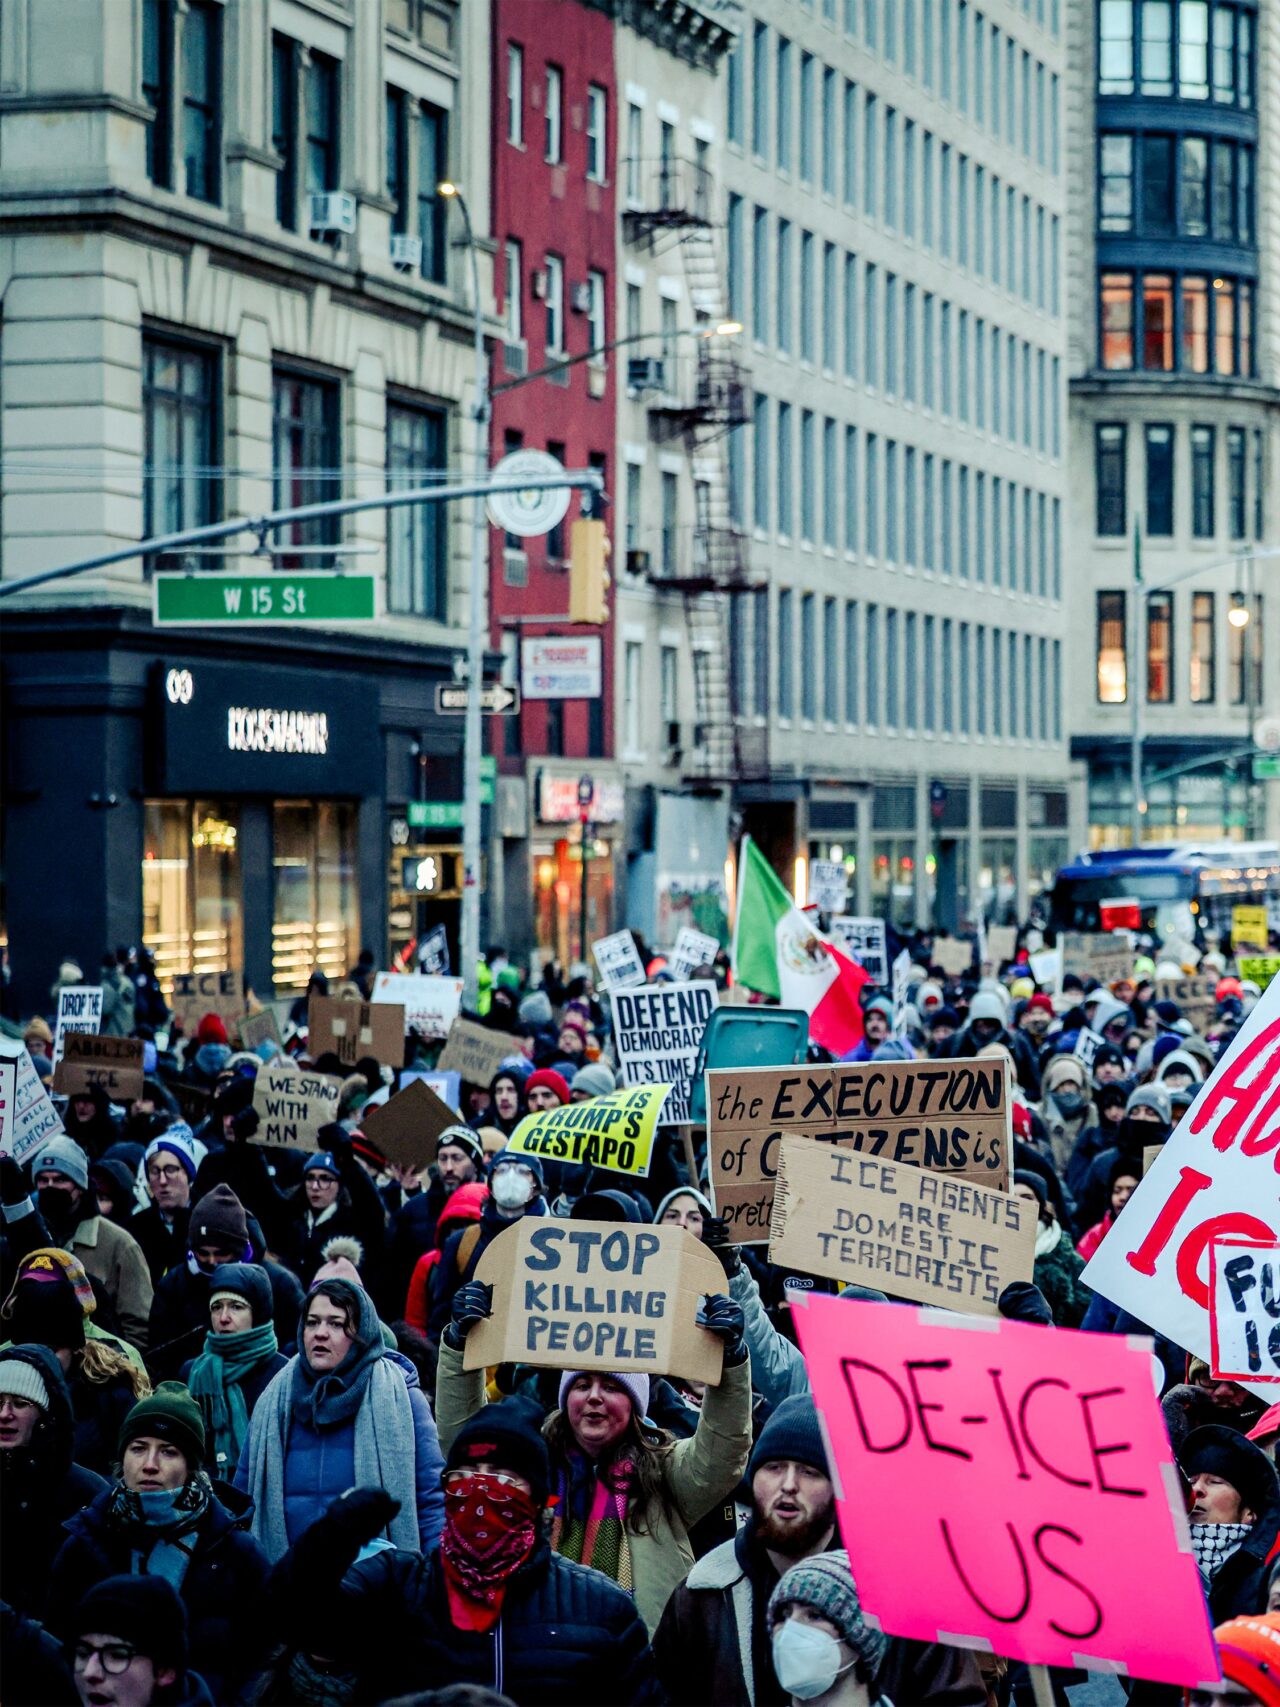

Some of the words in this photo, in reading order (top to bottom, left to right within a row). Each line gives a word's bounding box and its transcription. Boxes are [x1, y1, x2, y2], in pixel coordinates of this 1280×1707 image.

[223, 587, 242, 613] W
[251, 587, 273, 613] 15
[282, 586, 306, 613] St
[61, 993, 87, 1018] DROP
[175, 973, 234, 997] ICE
[616, 988, 713, 1031] DEFEND
[86, 1070, 119, 1088] ICE
[269, 1076, 295, 1094] WE
[298, 1079, 339, 1100] STAND
[626, 1058, 655, 1083] IT'S
[656, 1056, 690, 1082] TIME
[265, 1099, 308, 1120] WITH
[717, 1085, 763, 1121] the
[770, 1068, 1001, 1120] EXECUTION
[266, 1124, 297, 1142] MN
[536, 1107, 644, 1140] TRUMP'S
[522, 1126, 637, 1170] GESTAPO
[720, 1137, 752, 1177] of
[973, 1131, 1001, 1170] is
[721, 1196, 773, 1229] prett
[830, 1153, 898, 1195] ICE
[919, 1175, 1021, 1232] AGENTS
[898, 1202, 953, 1234] ARE
[1125, 1165, 1278, 1311] IC
[524, 1225, 661, 1276] STOP
[832, 1207, 1000, 1273] DOMESTIC
[816, 1231, 1000, 1305] TERRORISTS
[524, 1279, 667, 1319] KILLING
[526, 1315, 657, 1360] PEOPLE
[840, 1355, 1148, 1499] DE-ICE
[939, 1516, 1105, 1641] US
